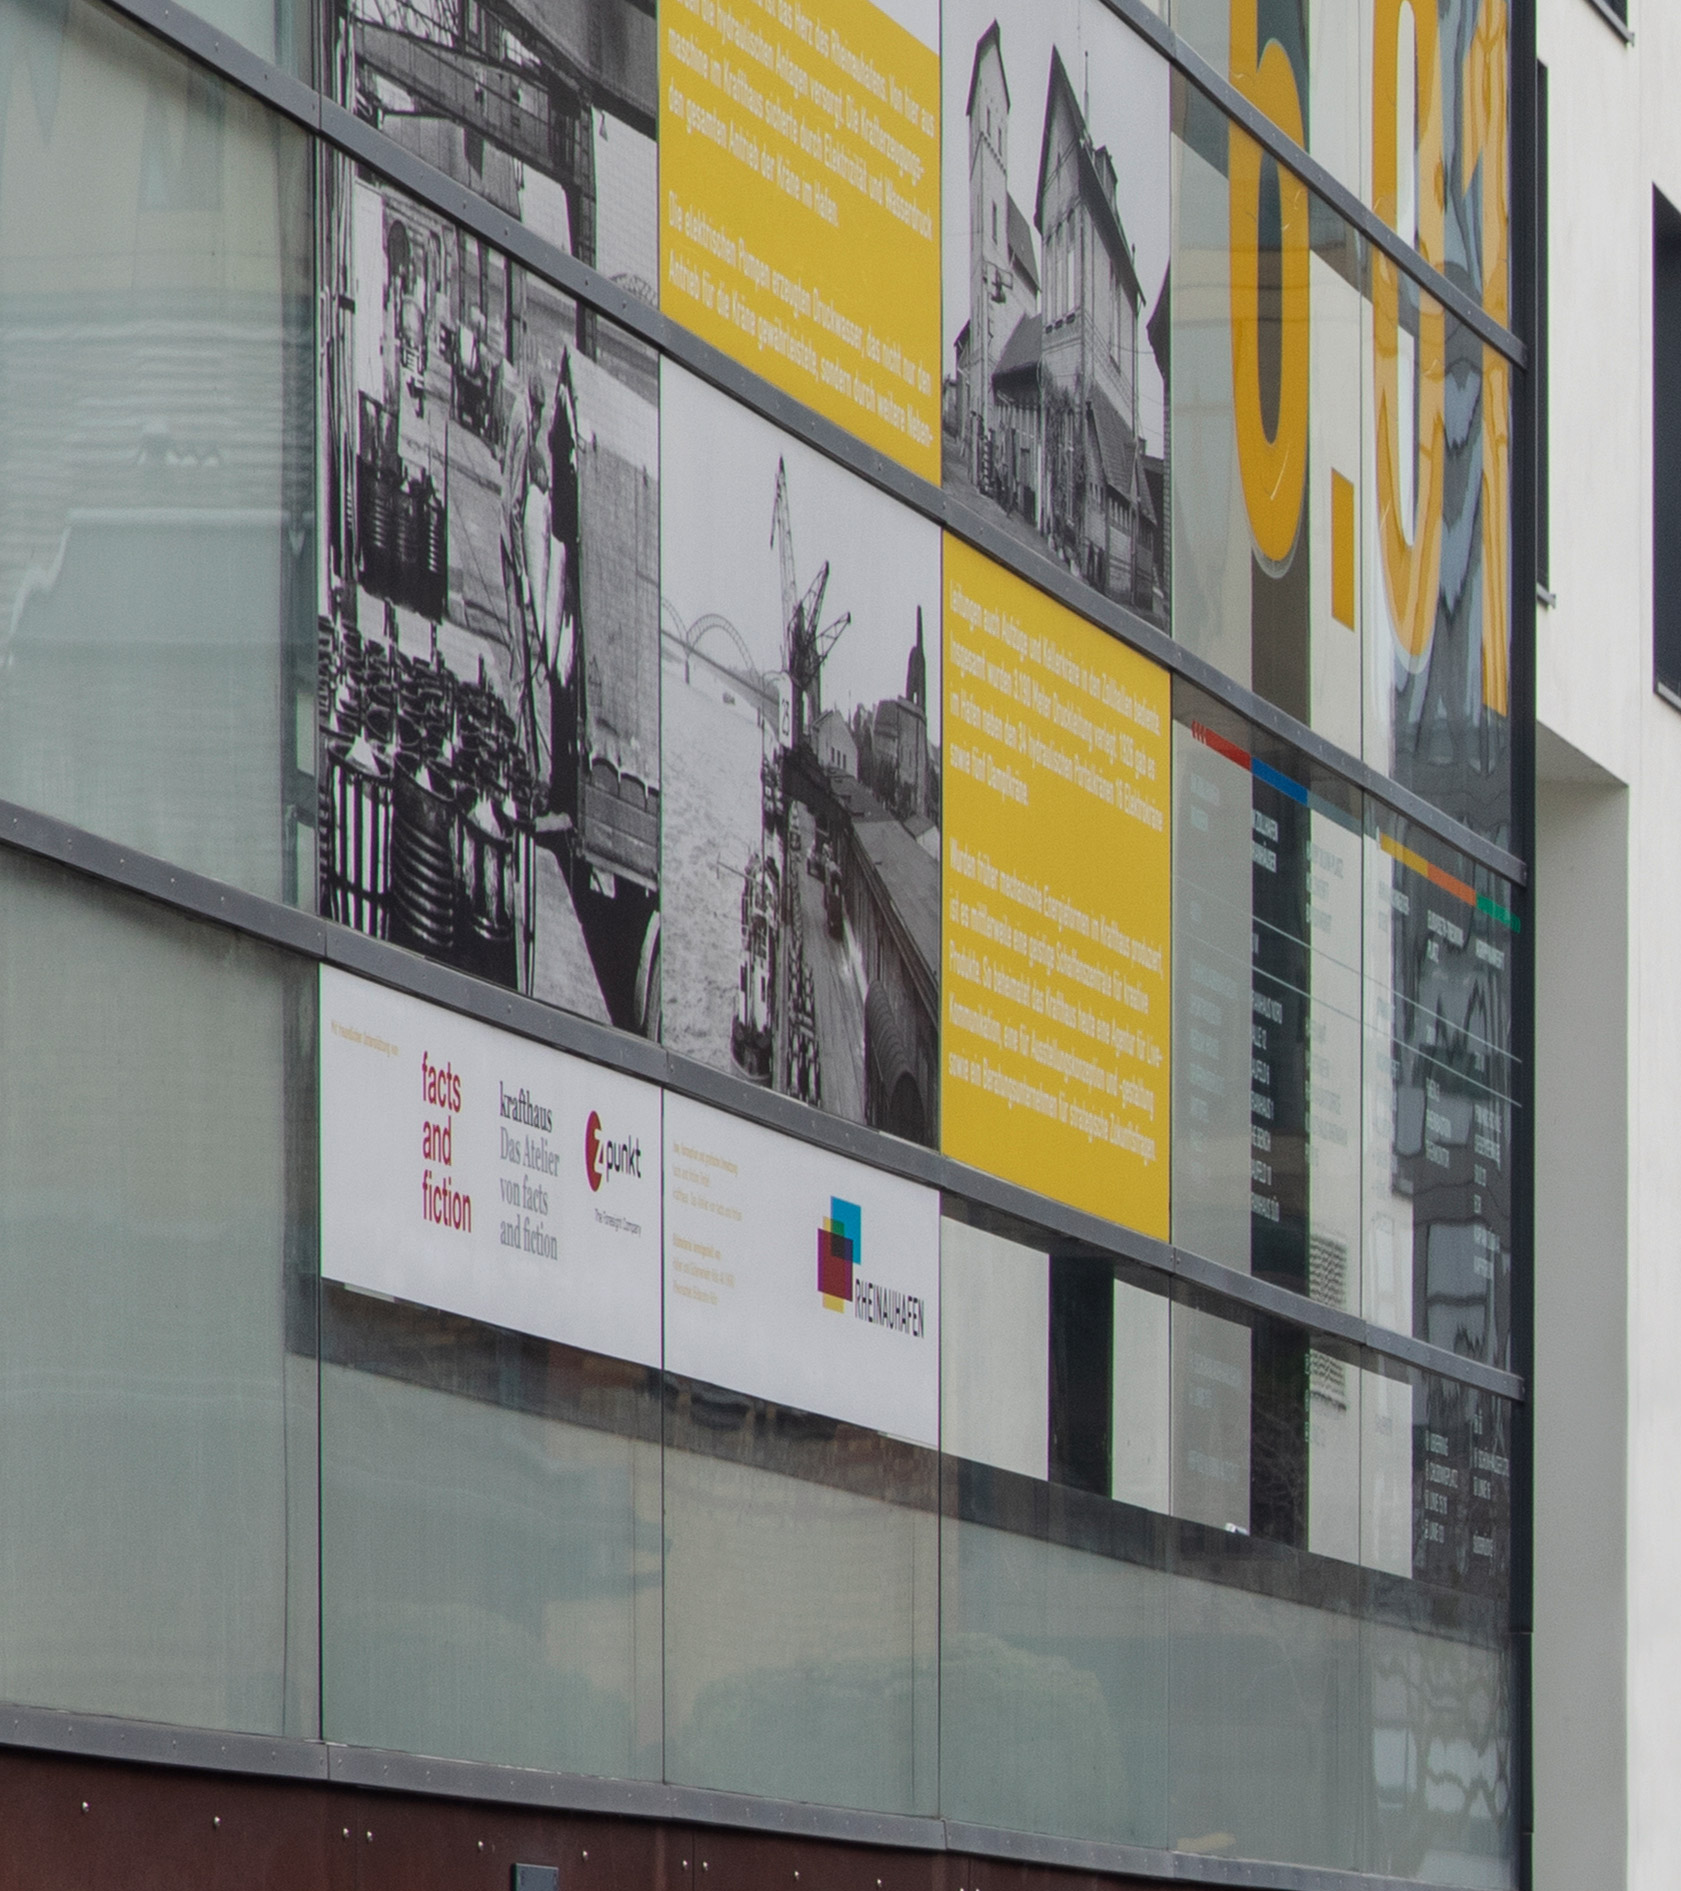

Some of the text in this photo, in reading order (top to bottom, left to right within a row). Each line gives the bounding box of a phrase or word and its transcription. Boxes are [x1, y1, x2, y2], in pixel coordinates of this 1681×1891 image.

[422, 1051, 461, 1113] facts
[500, 1081, 553, 1133] krafthaus
[423, 1116, 452, 1166] and
[500, 1126, 560, 1178] Das Atelier
[422, 1169, 472, 1233] fiction
[500, 1174, 549, 1216] von facts
[500, 1214, 558, 1261] and fiction
[855, 1278, 925, 1339] RHEINAUHAFEN
